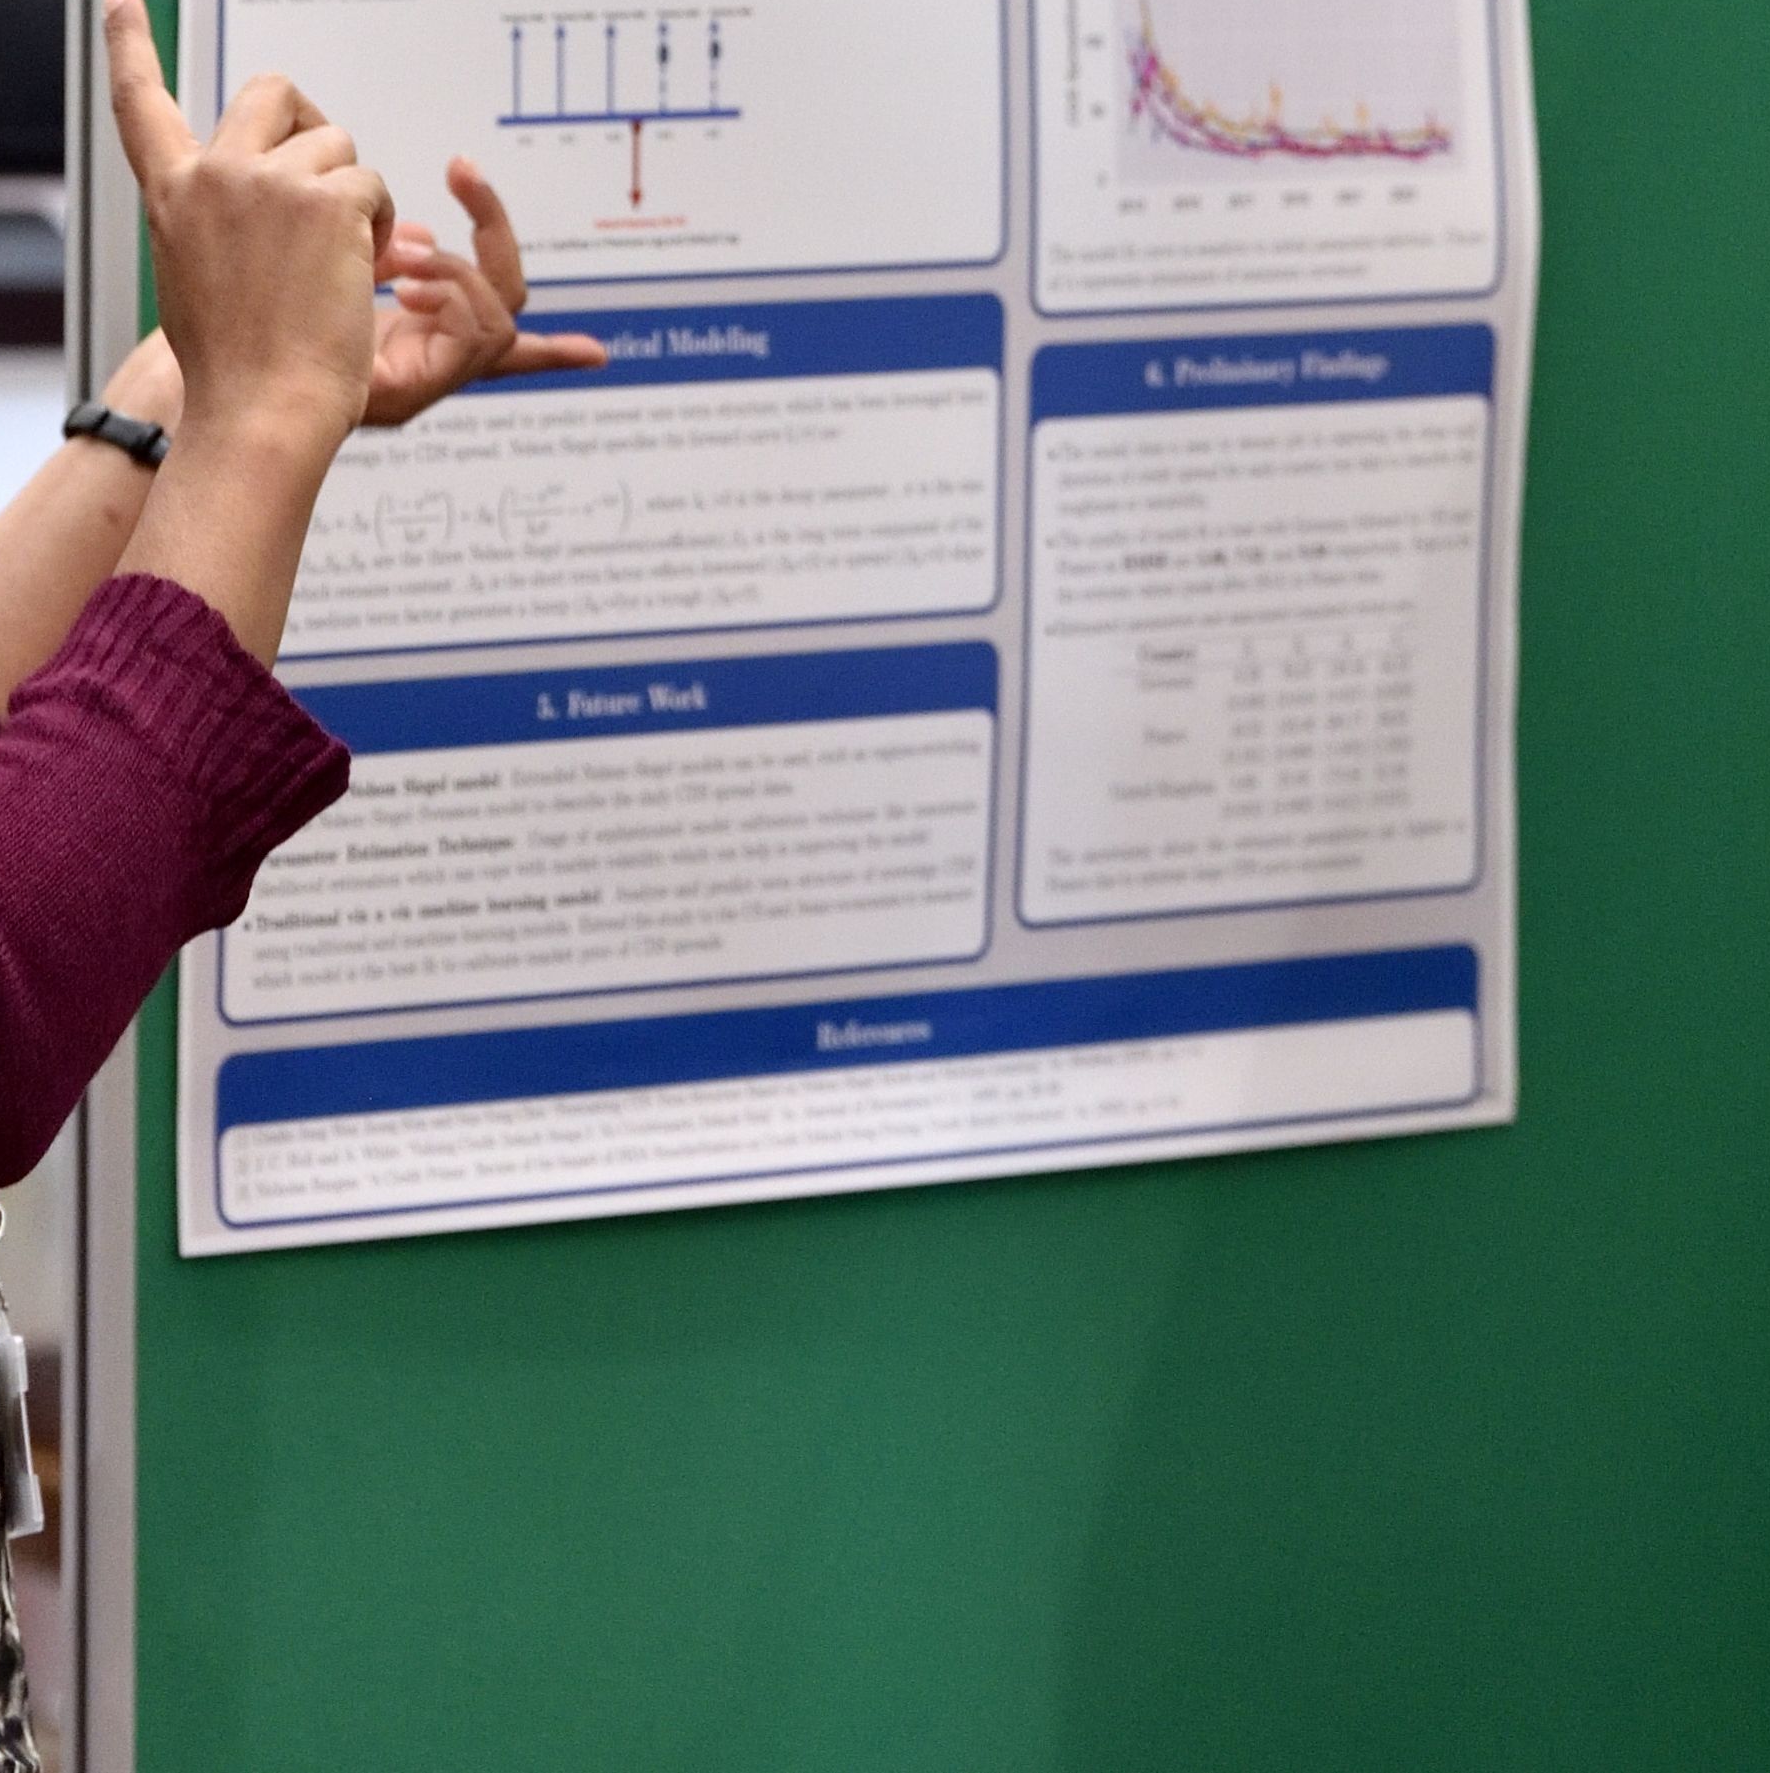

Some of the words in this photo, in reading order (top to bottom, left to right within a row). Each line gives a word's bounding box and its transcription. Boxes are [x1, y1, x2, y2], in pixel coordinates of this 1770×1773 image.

[667, 323, 771, 359] Modeling
[566, 688, 642, 719] Future
[647, 680, 707, 712] Work
[263, 848, 337, 869] arameter
